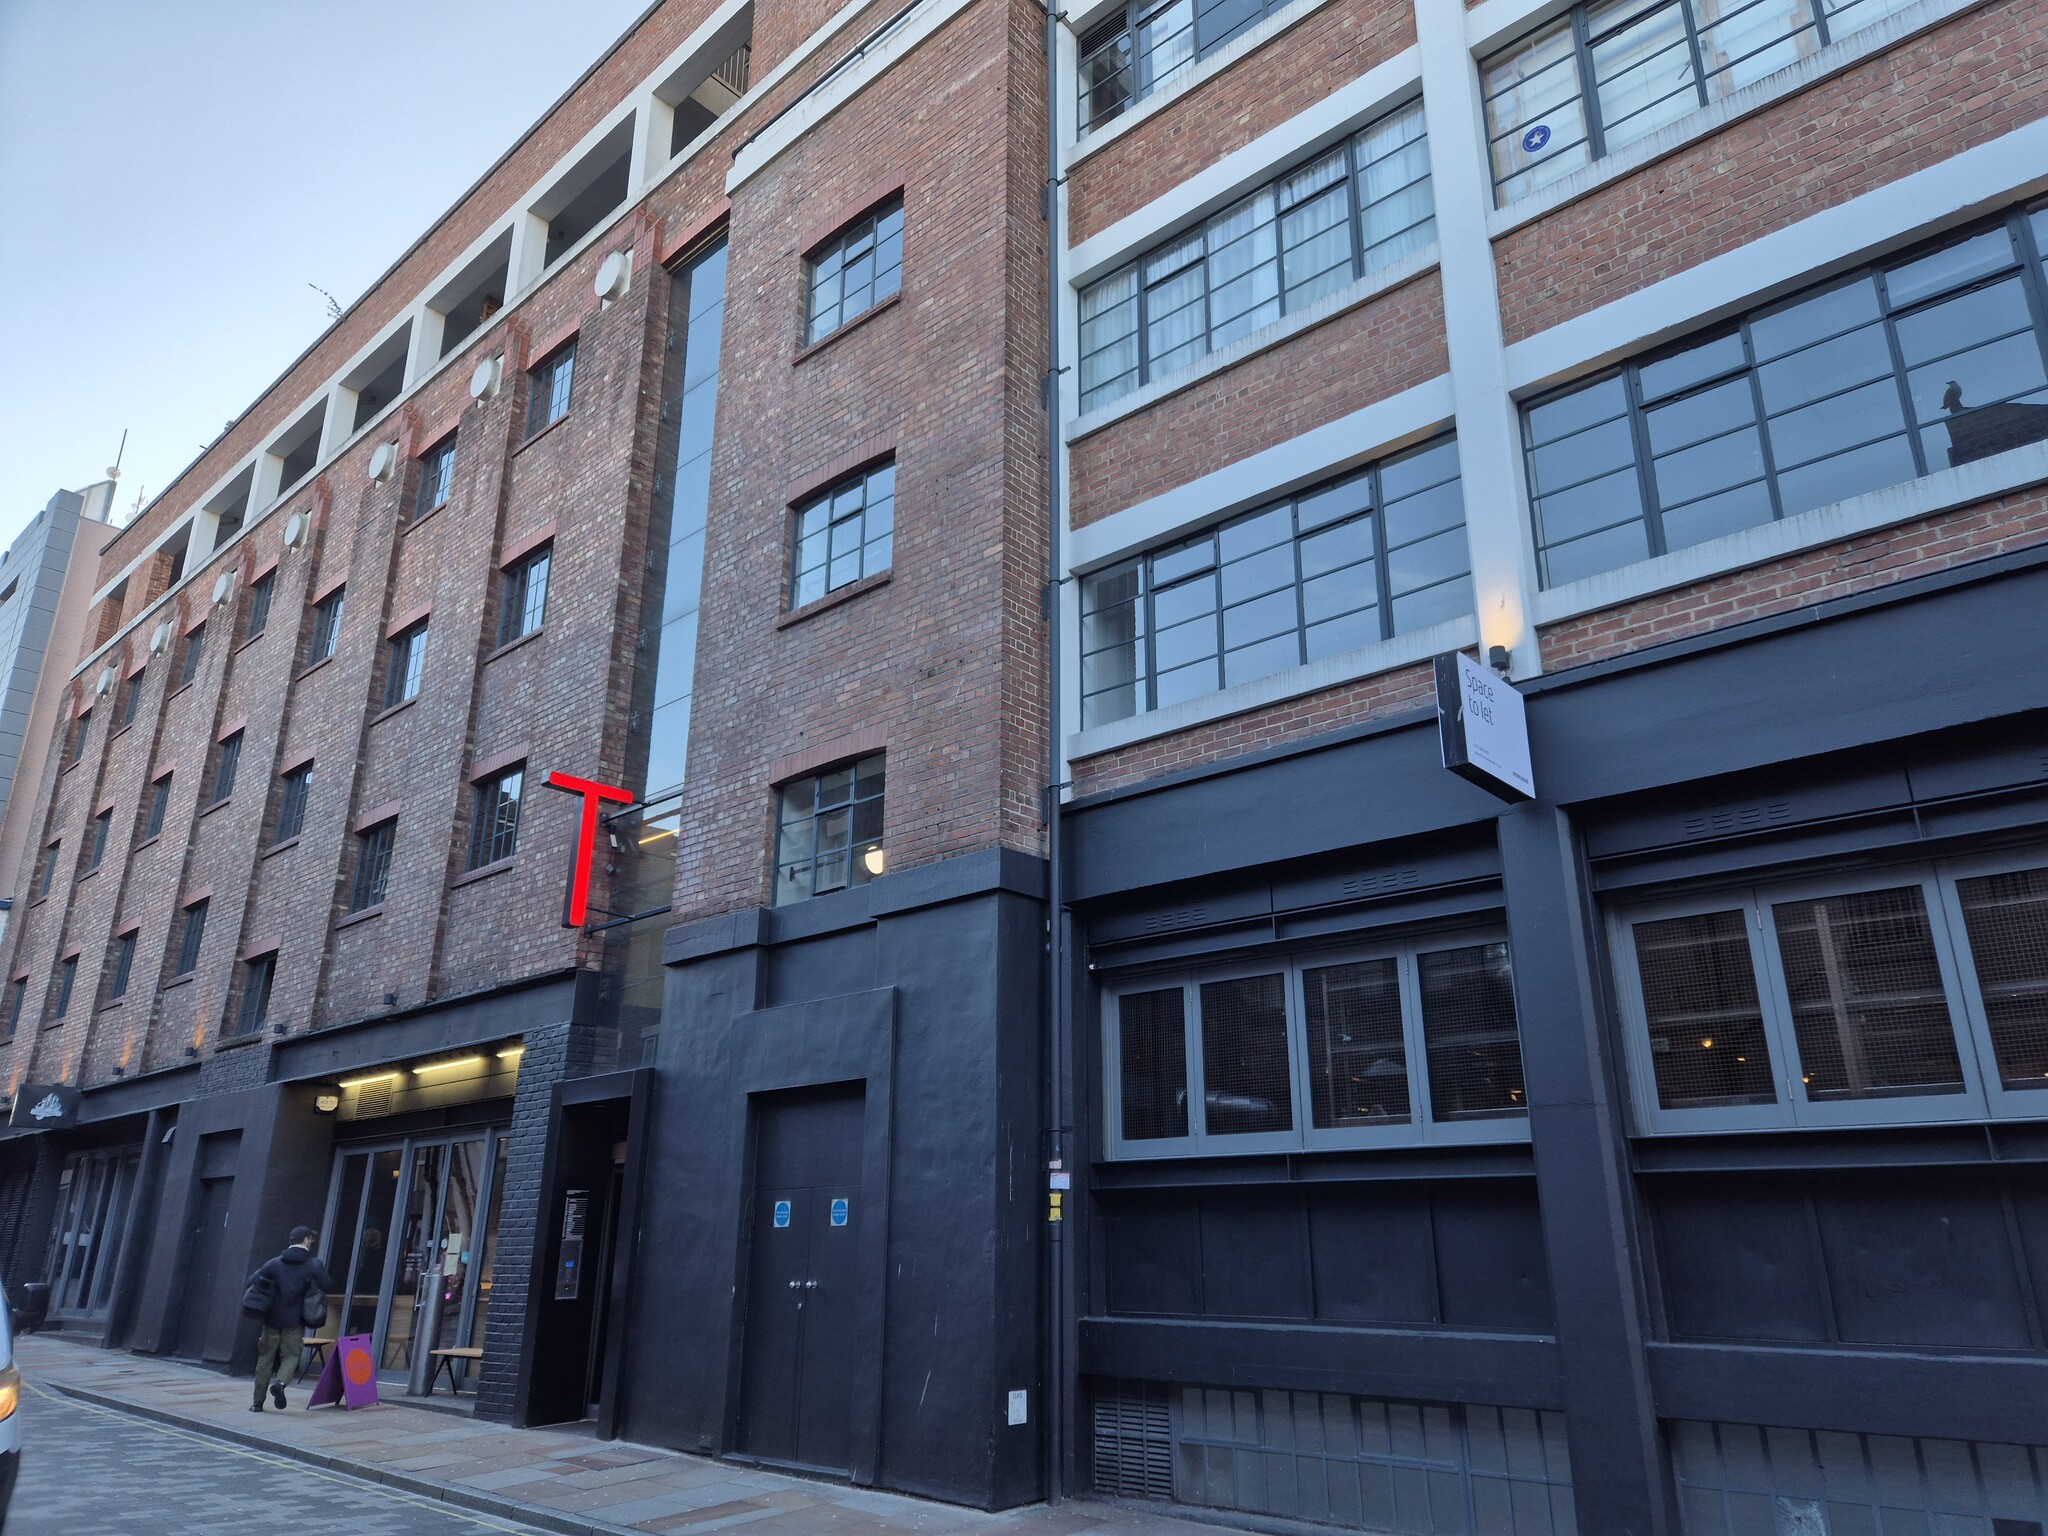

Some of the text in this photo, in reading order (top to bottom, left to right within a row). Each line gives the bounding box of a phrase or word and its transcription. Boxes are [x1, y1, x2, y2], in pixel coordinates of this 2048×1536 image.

[1465, 668, 1494, 703] Space
[1468, 694, 1494, 726] to let
[549, 770, 634, 927] T
